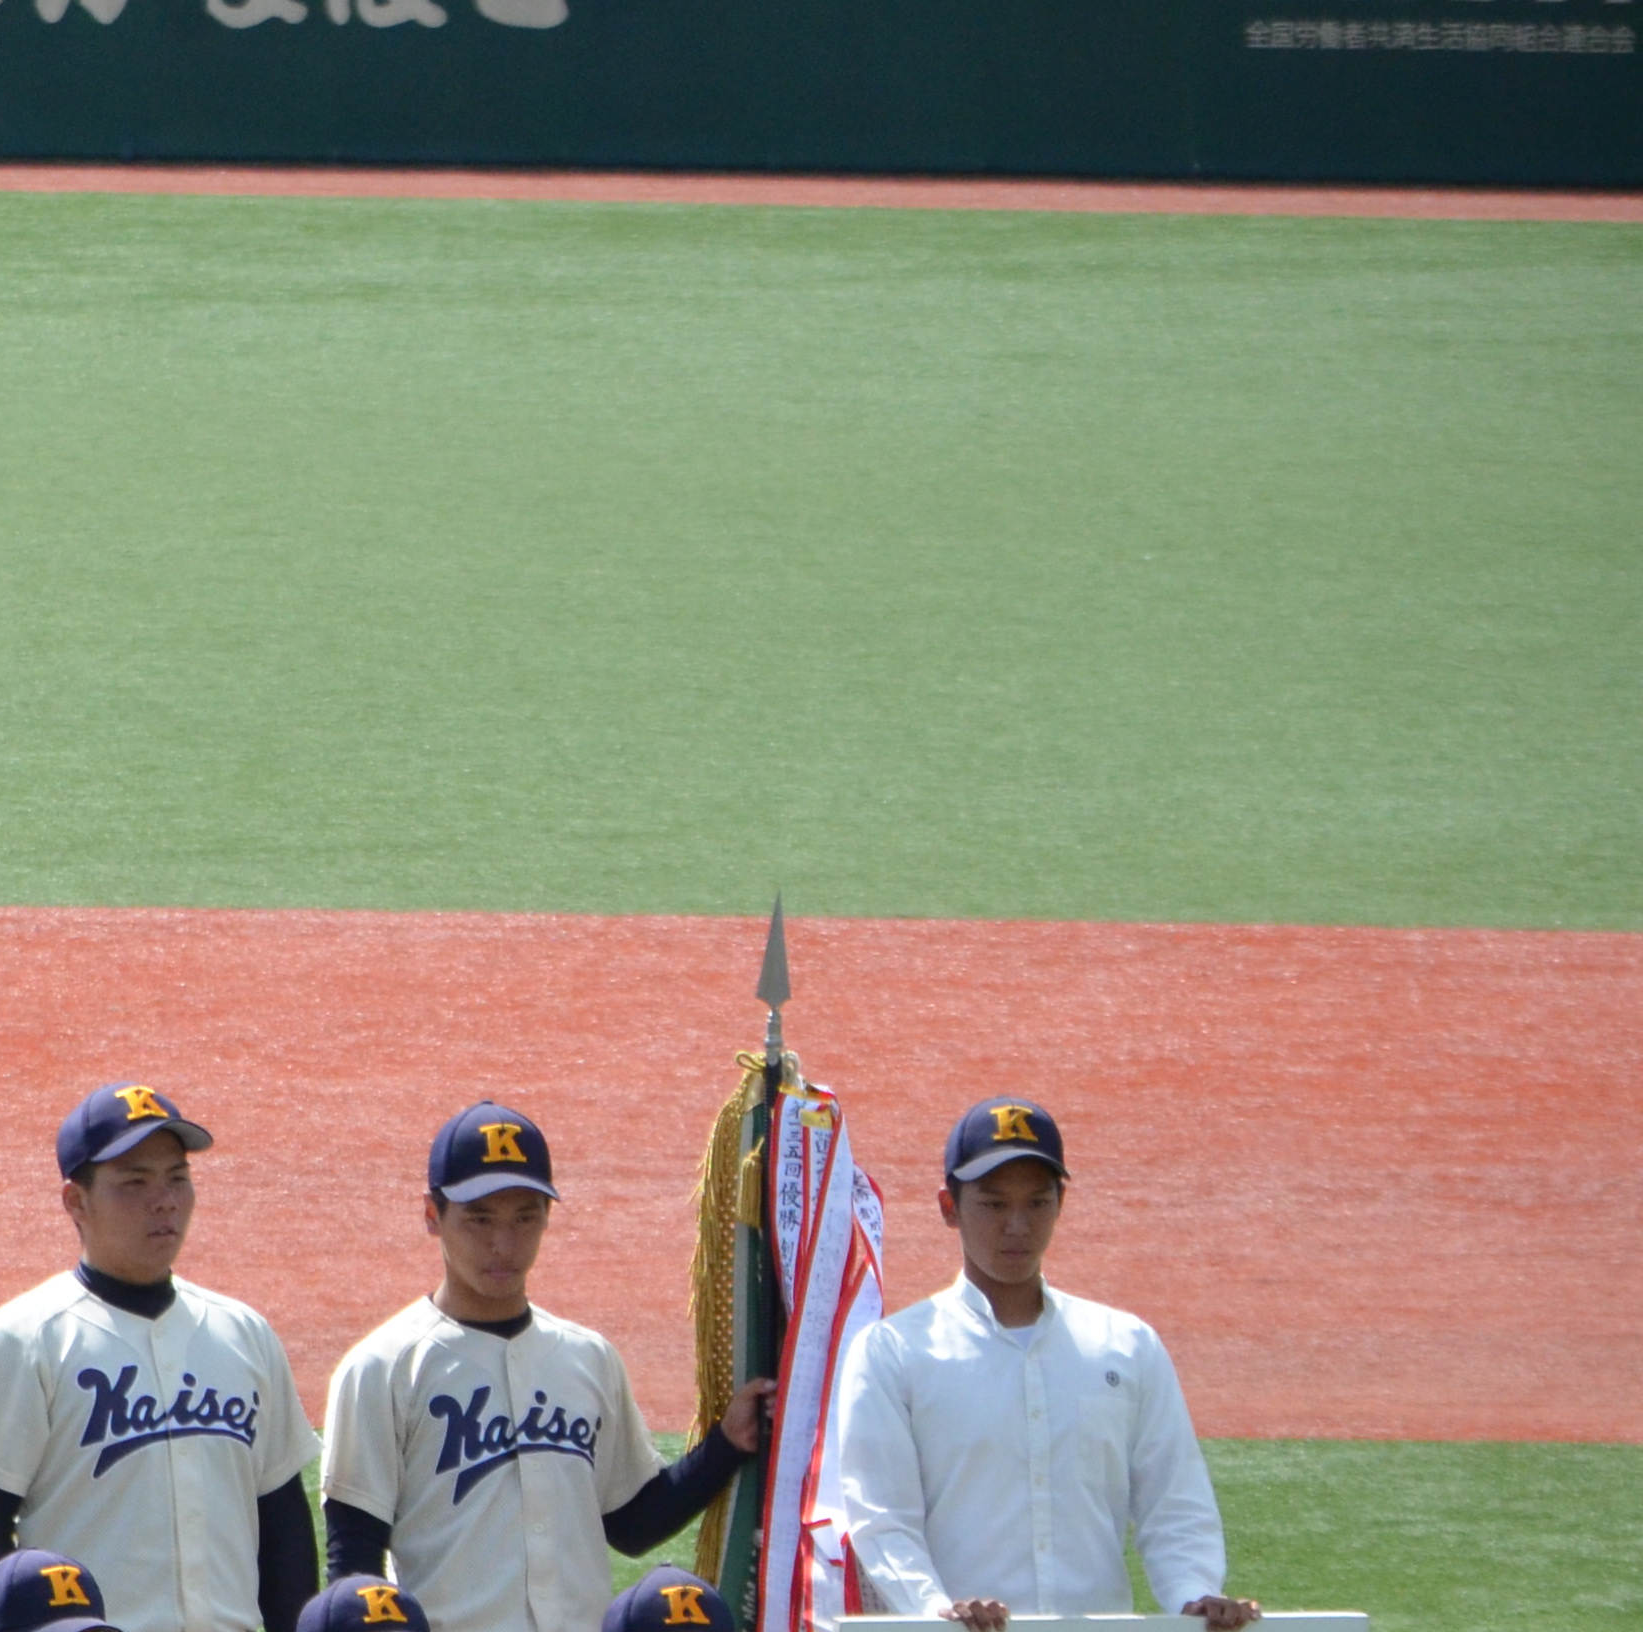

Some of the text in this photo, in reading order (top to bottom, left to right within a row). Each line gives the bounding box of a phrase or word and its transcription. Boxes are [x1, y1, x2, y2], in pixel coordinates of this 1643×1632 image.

[115, 1086, 169, 1120] K
[989, 1105, 1039, 1142] K
[479, 1122, 528, 1163] K
[77, 1364, 259, 1478] Kaisei
[40, 1564, 91, 1606] K
[356, 1585, 408, 1624] K
[659, 1585, 711, 1626] K
